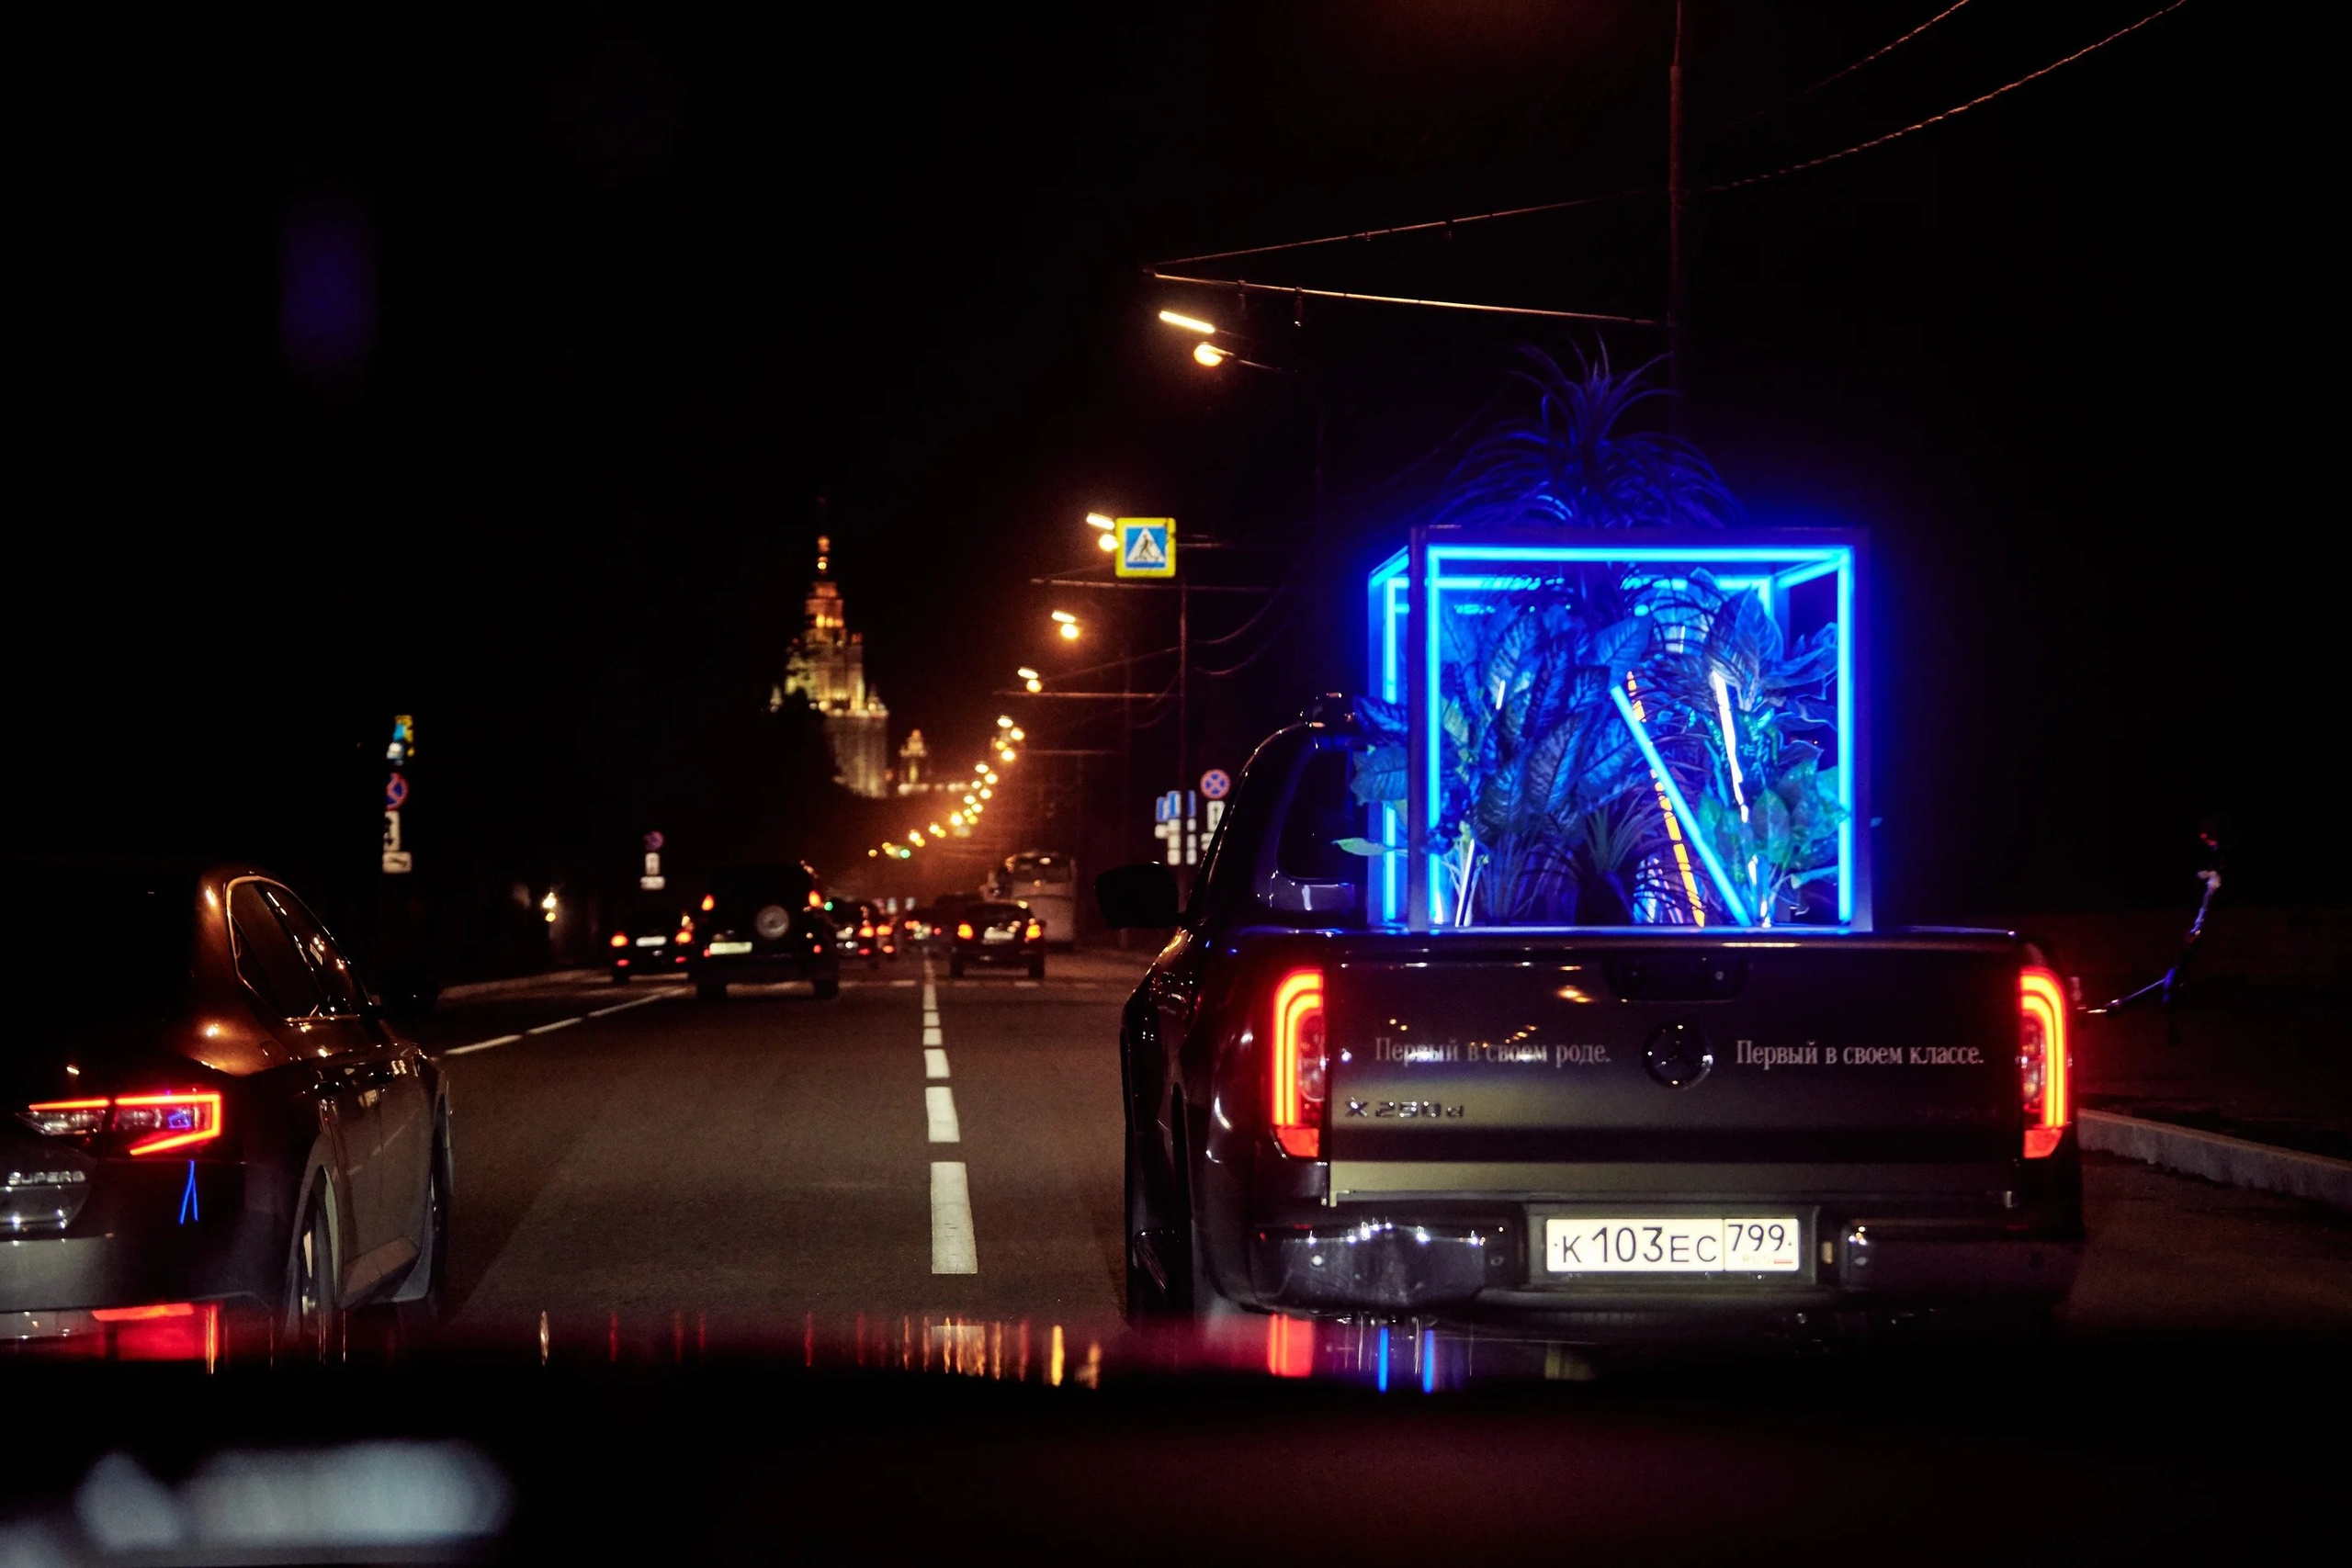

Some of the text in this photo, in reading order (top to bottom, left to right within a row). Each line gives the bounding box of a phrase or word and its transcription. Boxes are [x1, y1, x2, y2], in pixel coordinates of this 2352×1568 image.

[1375, 1036, 1611, 1068] Первый в своем роде.
[1736, 1038, 1985, 1070] Первый в своем классе.
[7, 1169, 86, 1186] SUPERB
[1726, 1224, 1786, 1252] 799
